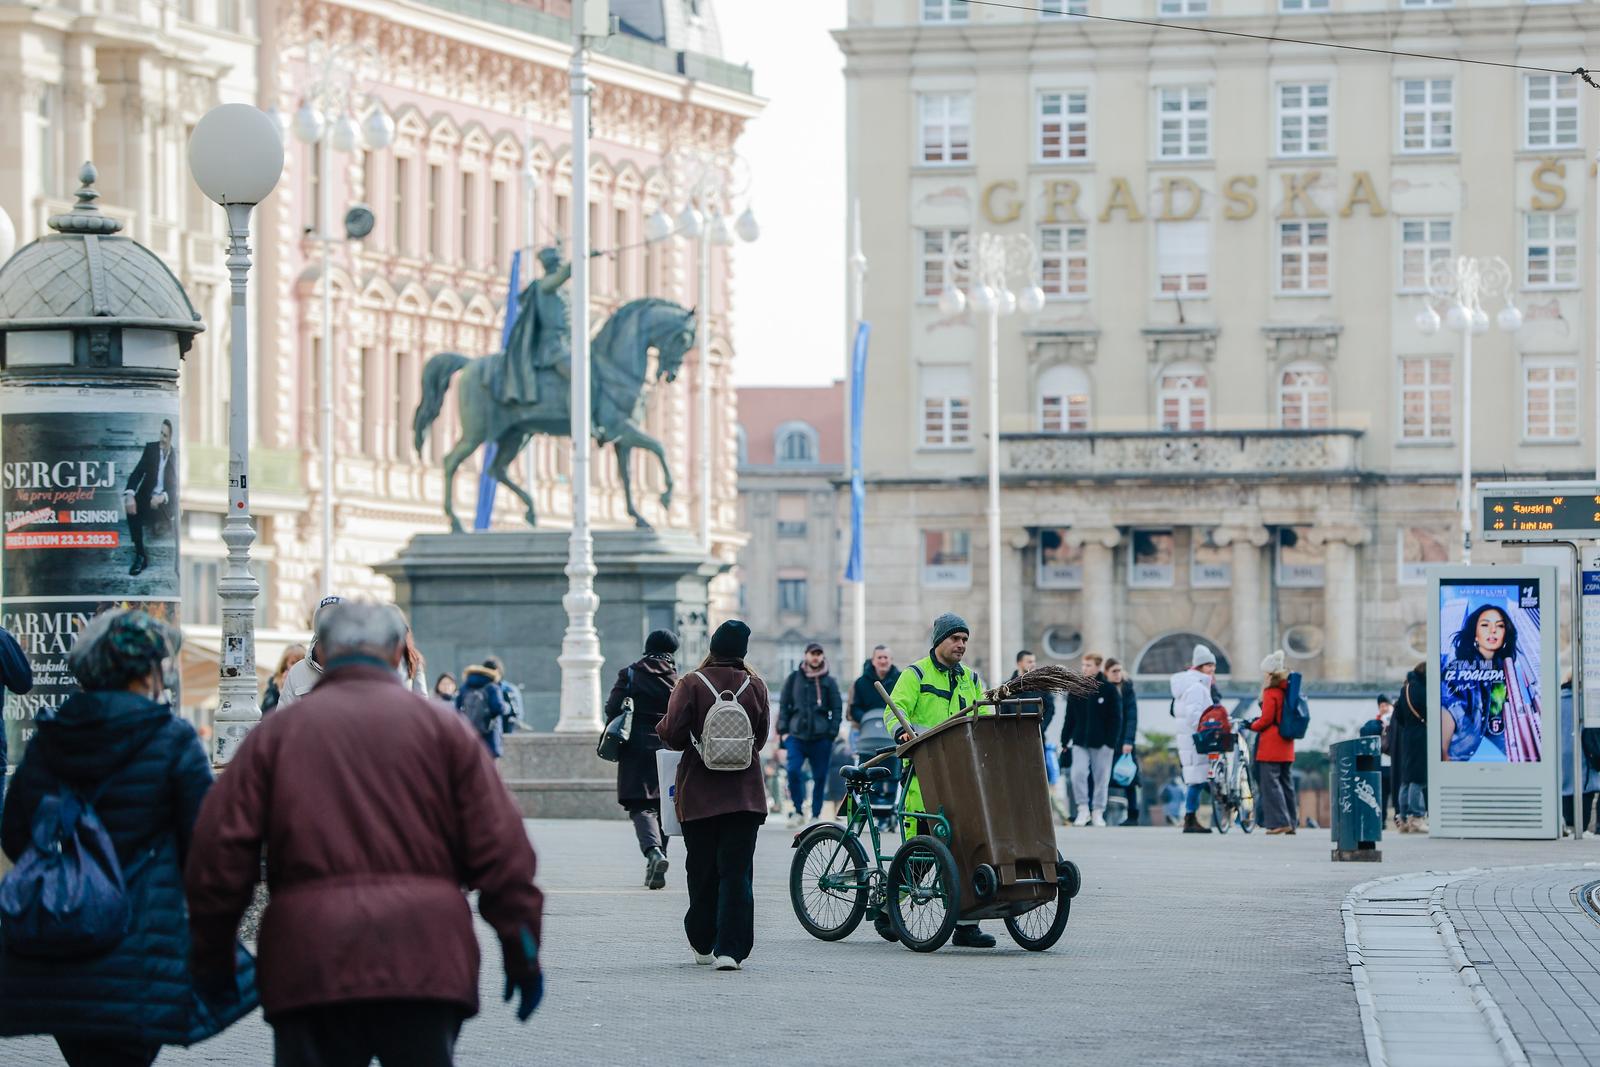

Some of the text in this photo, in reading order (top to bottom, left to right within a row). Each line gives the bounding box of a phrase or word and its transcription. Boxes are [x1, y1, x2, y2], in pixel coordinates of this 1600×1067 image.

[980, 172, 1387, 224] GRADSKA
[4, 461, 115, 489] SERGEJ
[53, 487, 95, 504] pogled
[71, 510, 118, 523] LISINSKI
[26, 536, 59, 545] DATUM
[1445, 670, 1456, 680] IZ
